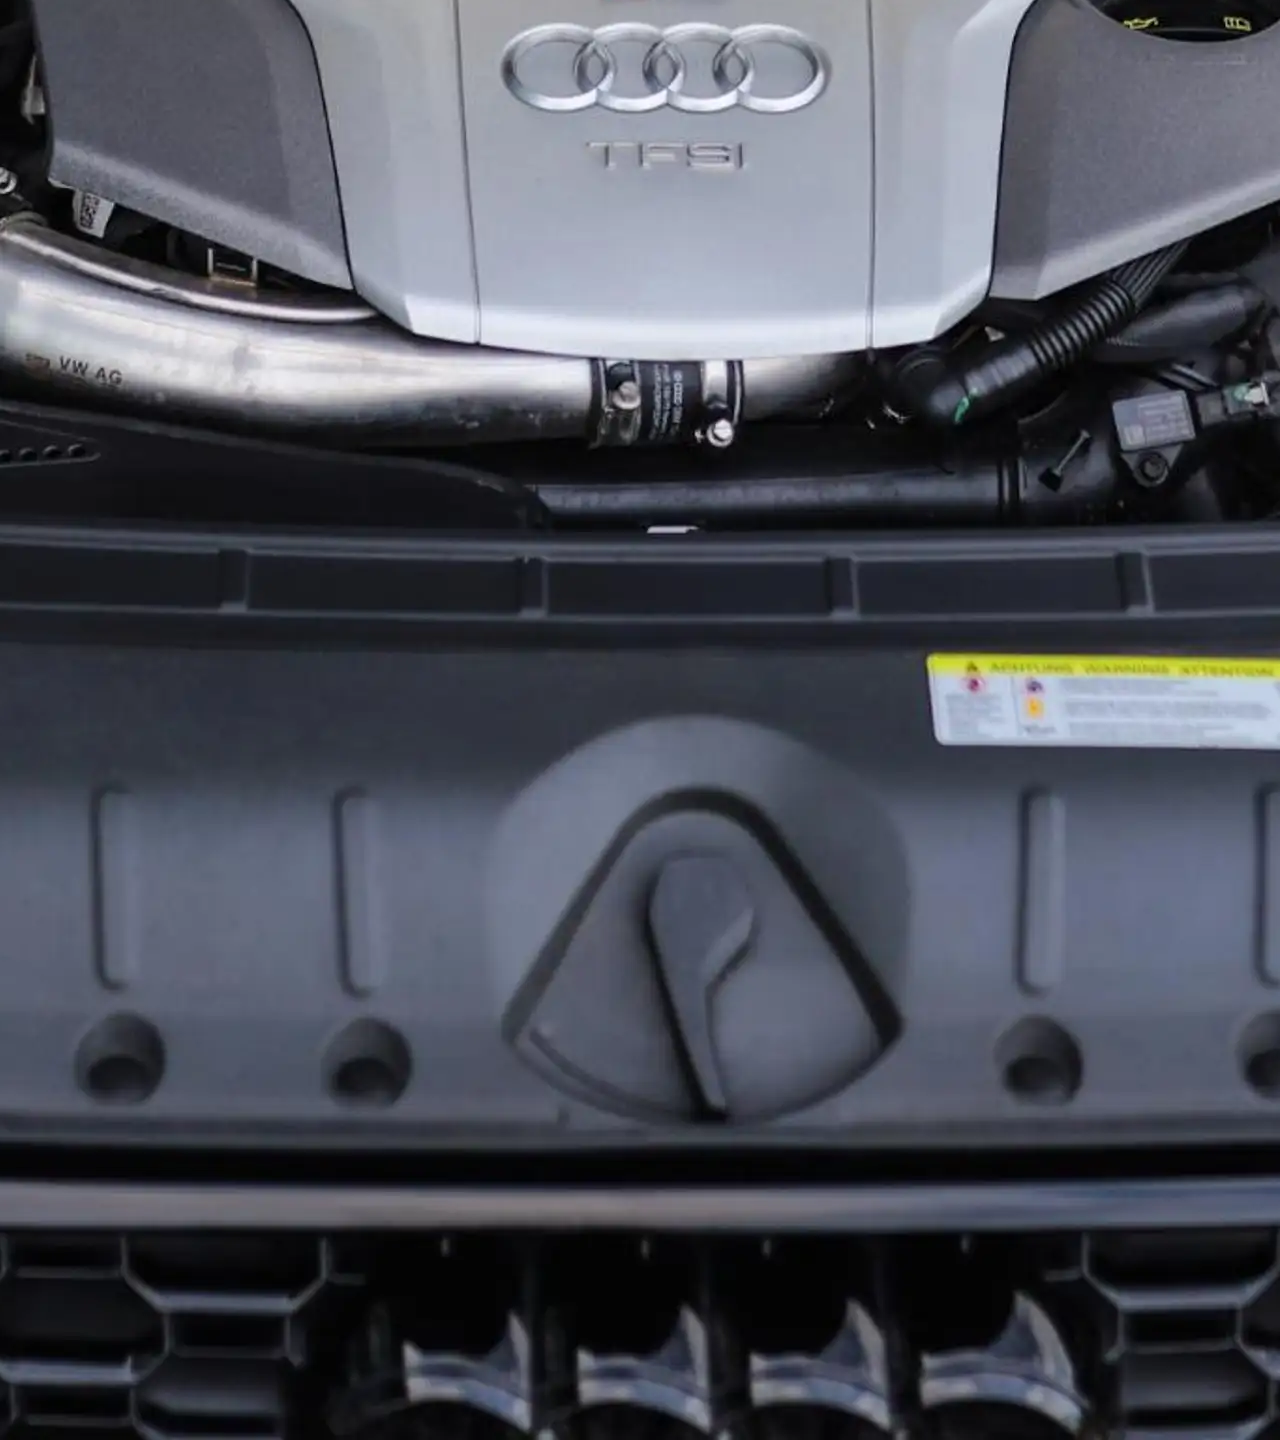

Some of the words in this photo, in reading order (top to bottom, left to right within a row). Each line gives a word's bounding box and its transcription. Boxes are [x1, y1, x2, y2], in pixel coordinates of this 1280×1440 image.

[586, 139, 747, 171] TFSI
[59, 355, 90, 377] VW
[94, 366, 123, 386] AG
